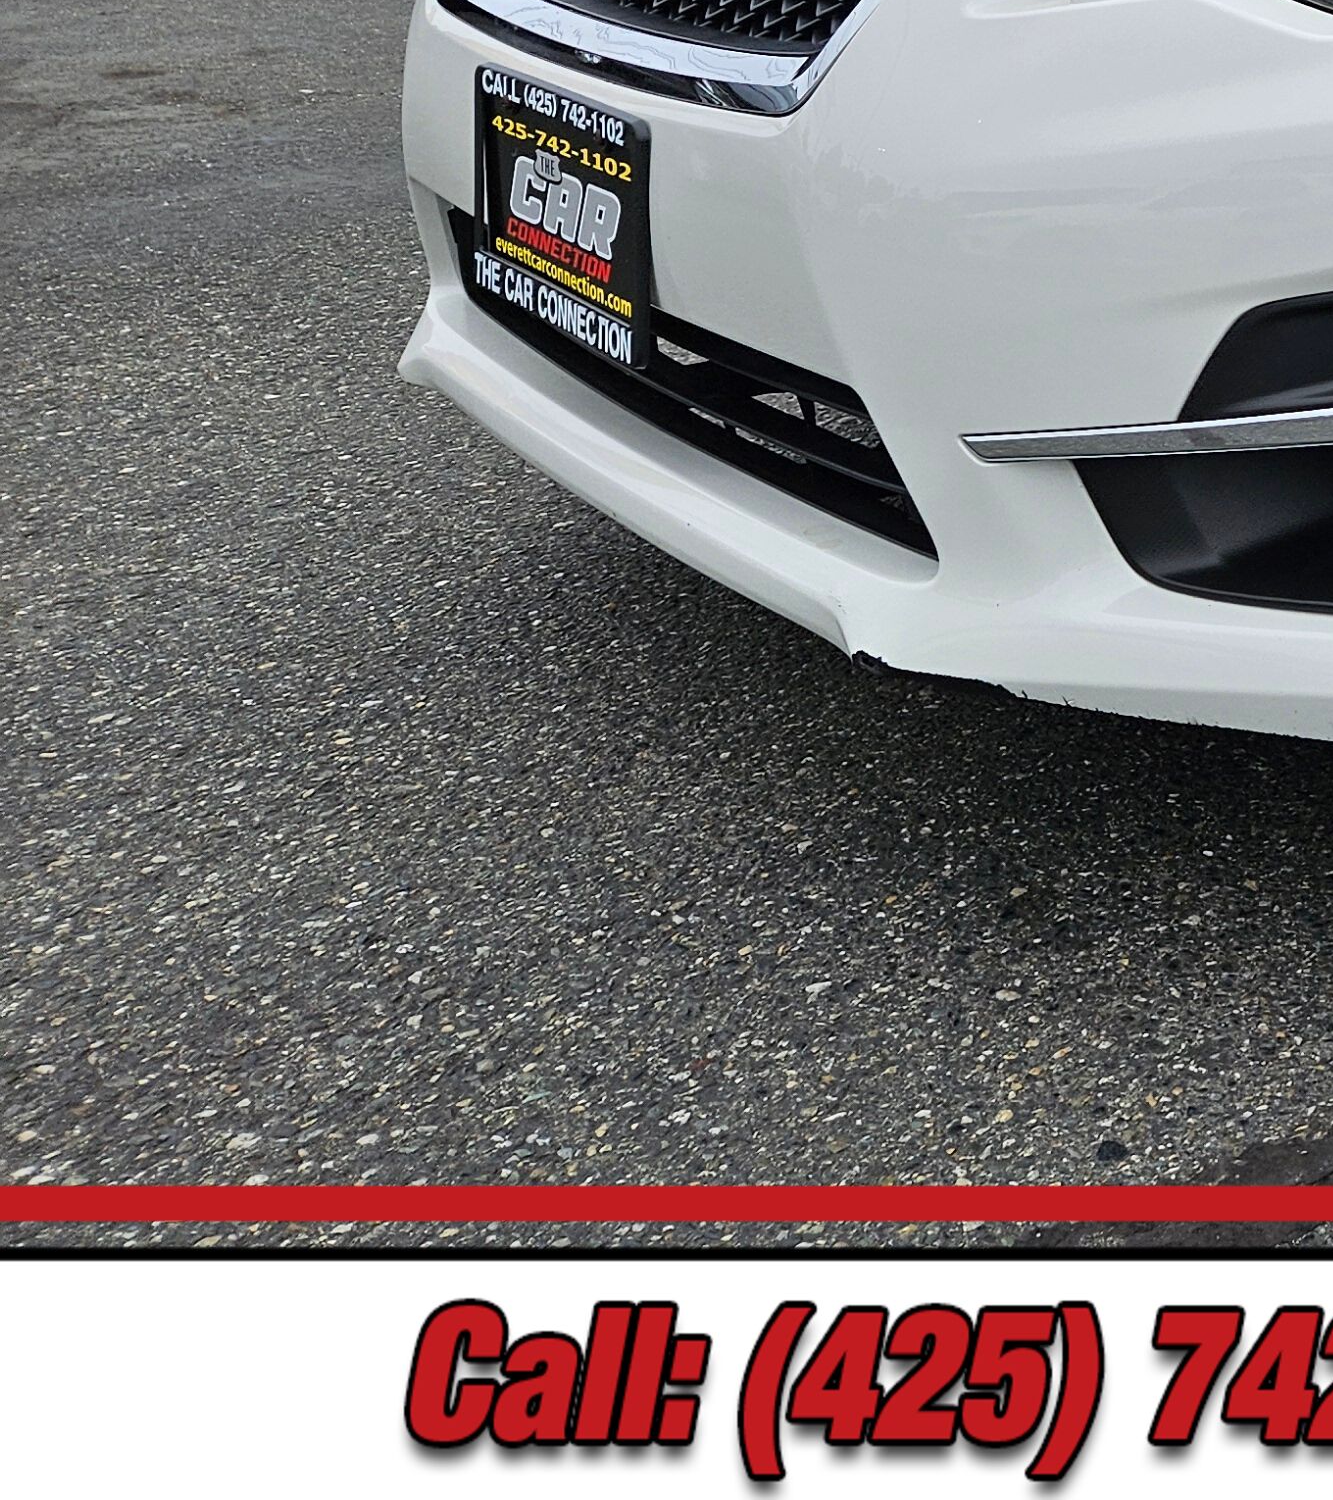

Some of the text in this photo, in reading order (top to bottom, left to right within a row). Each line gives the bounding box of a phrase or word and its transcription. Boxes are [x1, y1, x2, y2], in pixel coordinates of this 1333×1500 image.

[482, 68, 625, 146] CALL (425) 742-1102
[491, 115, 632, 182] 425-742-1102
[539, 155, 556, 178] THE
[509, 155, 622, 261] CAR
[495, 236, 632, 318] everettcarconnection.com
[506, 216, 612, 283] CONNECTION
[474, 251, 633, 365] THE CAR CONNECTION
